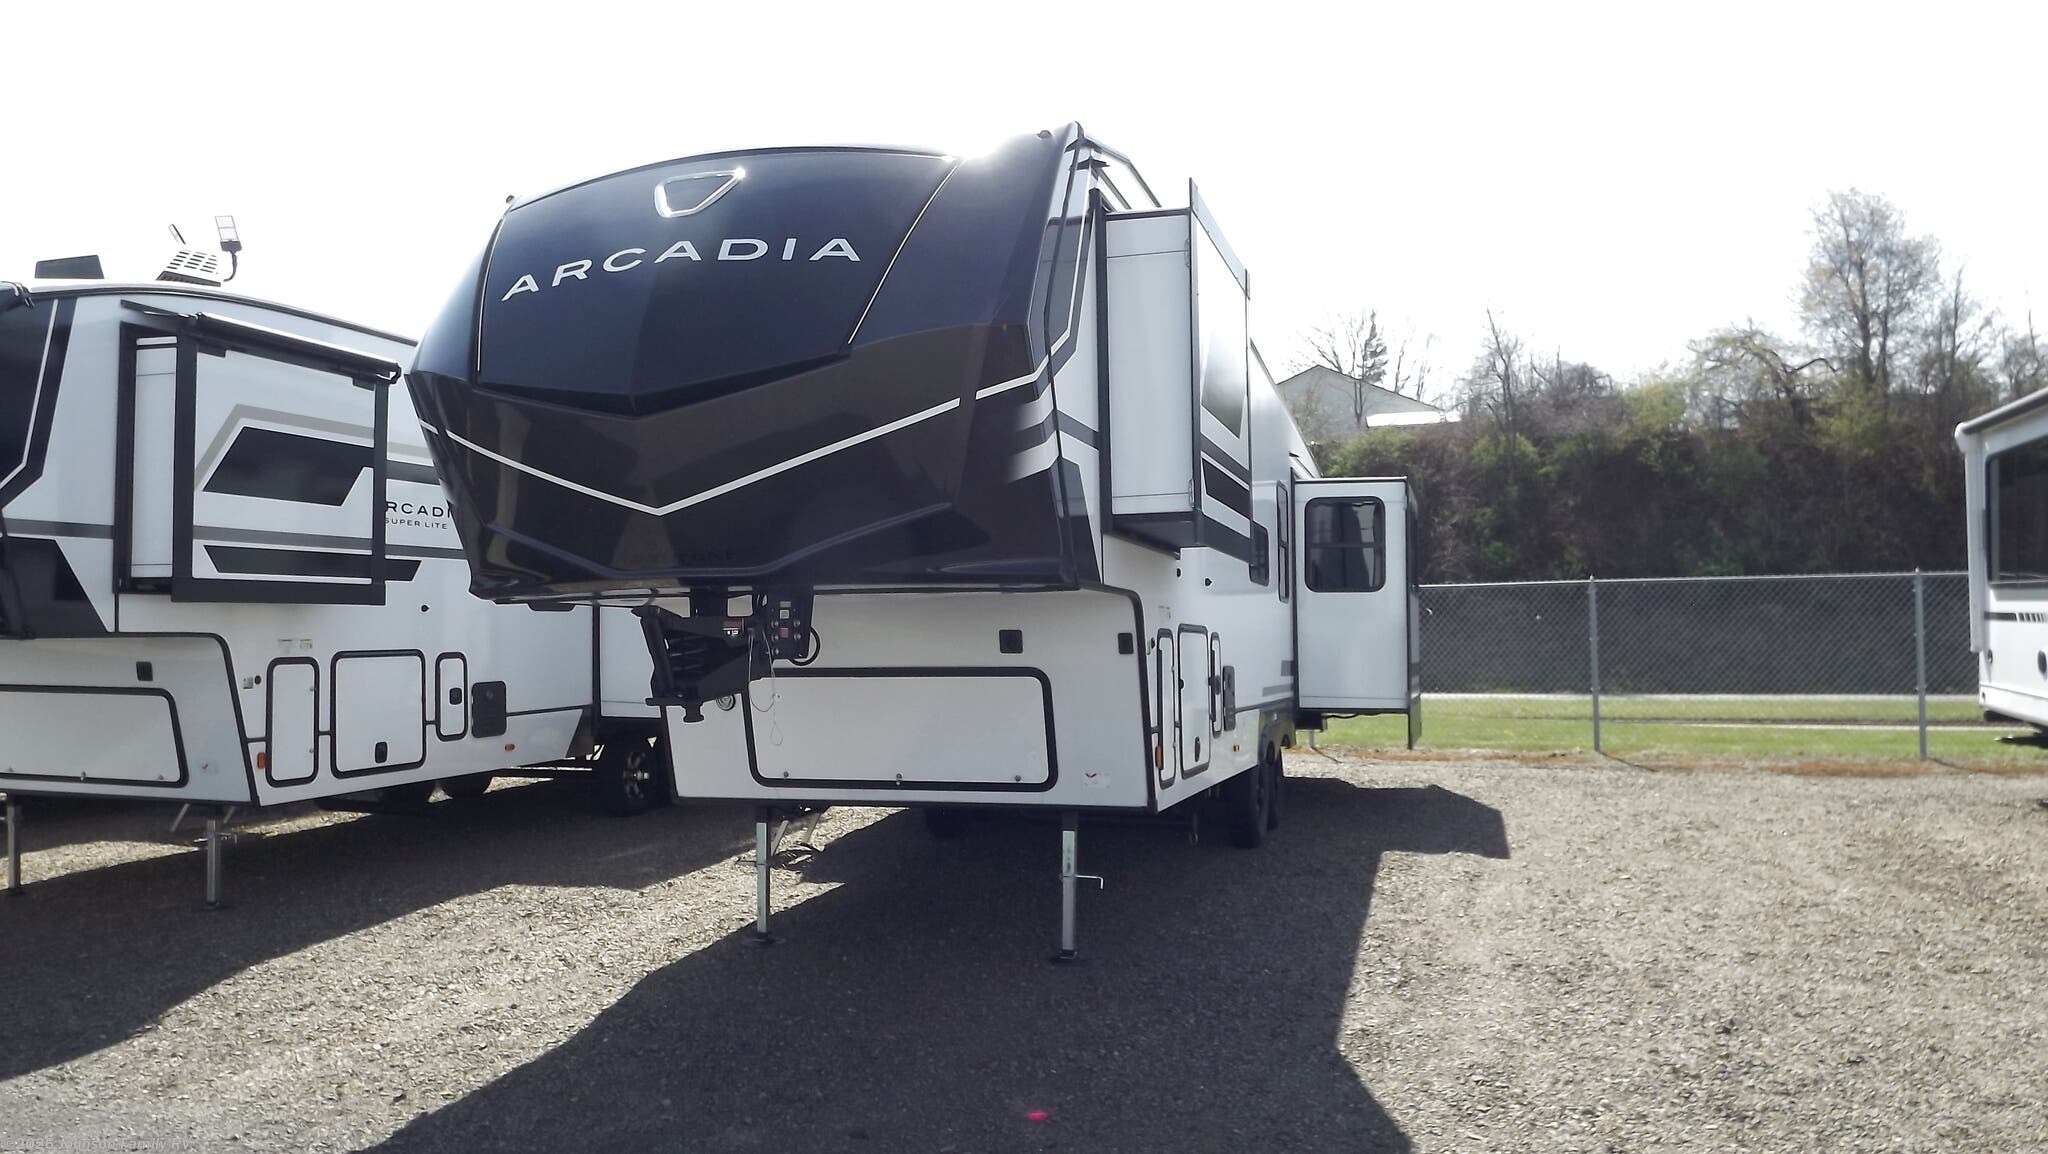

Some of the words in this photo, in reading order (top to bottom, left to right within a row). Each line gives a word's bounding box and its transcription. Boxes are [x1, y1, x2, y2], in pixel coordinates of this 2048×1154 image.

[501, 238, 861, 301] ARCADIA
[385, 501, 451, 518] RCADI
[385, 518, 420, 527] SUPER
[424, 522, 448, 530] LITE
